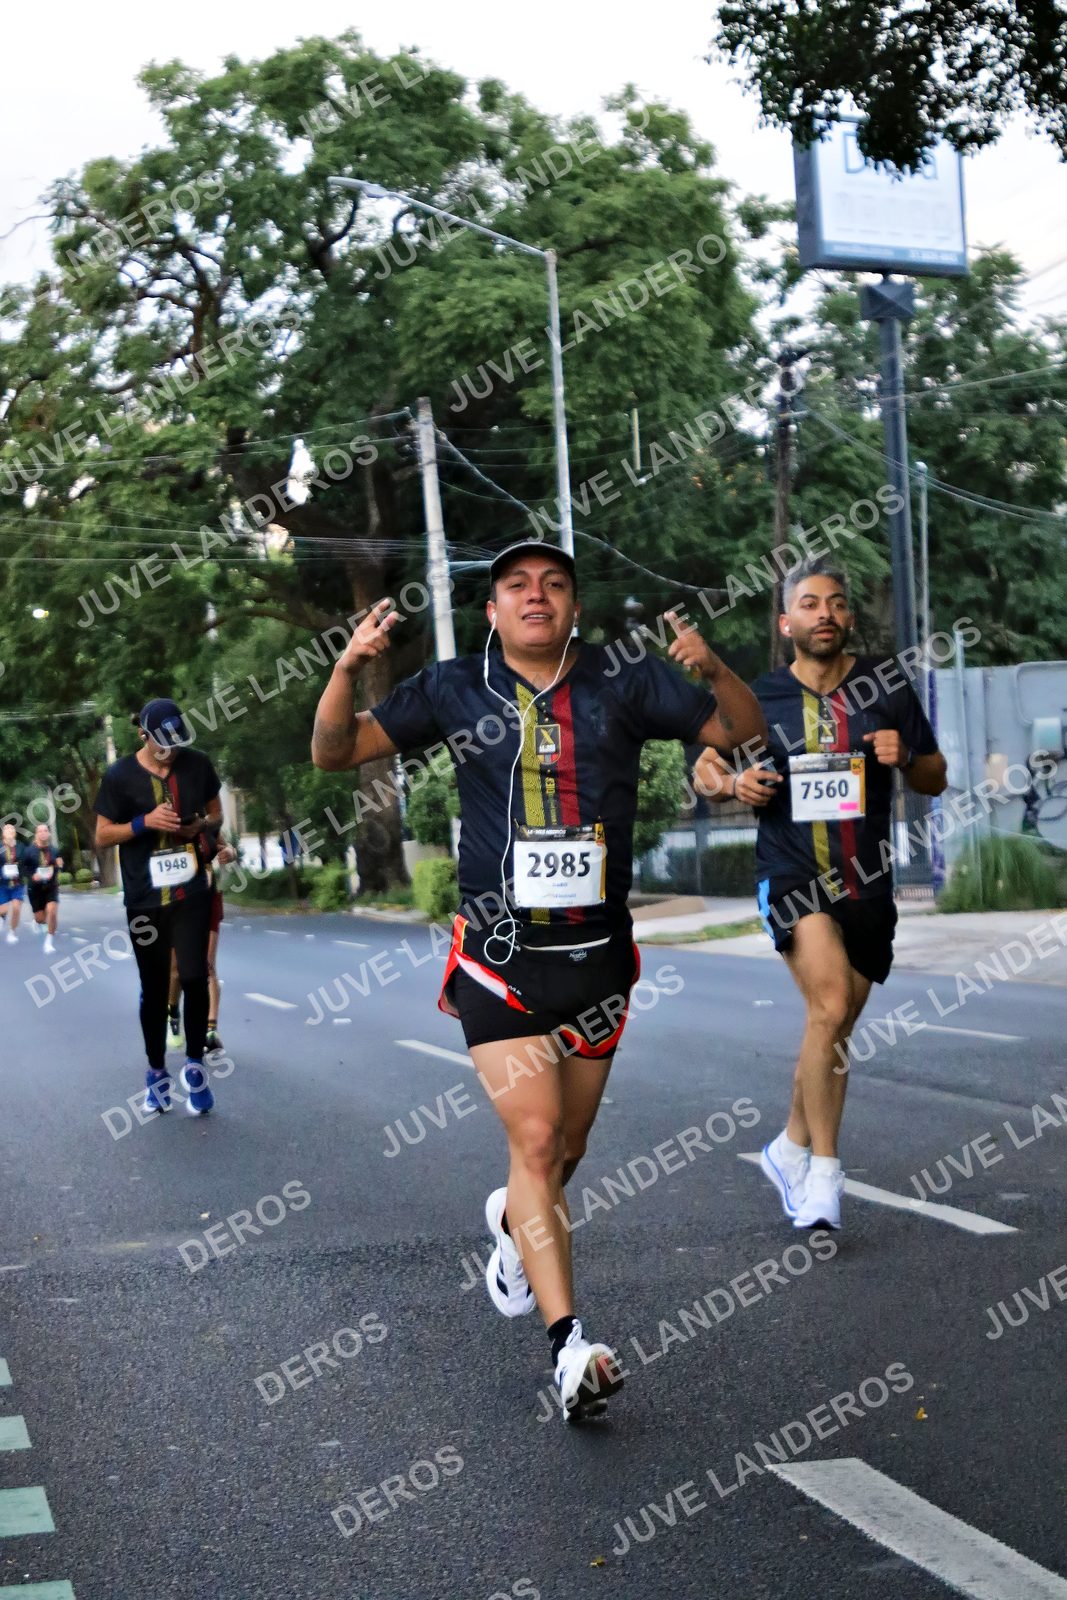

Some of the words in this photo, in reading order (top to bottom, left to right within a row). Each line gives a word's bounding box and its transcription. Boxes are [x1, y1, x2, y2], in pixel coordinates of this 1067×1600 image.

[801, 779, 848, 799] 7560
[157, 857, 187, 872] 1948
[527, 852, 590, 877] 2985
